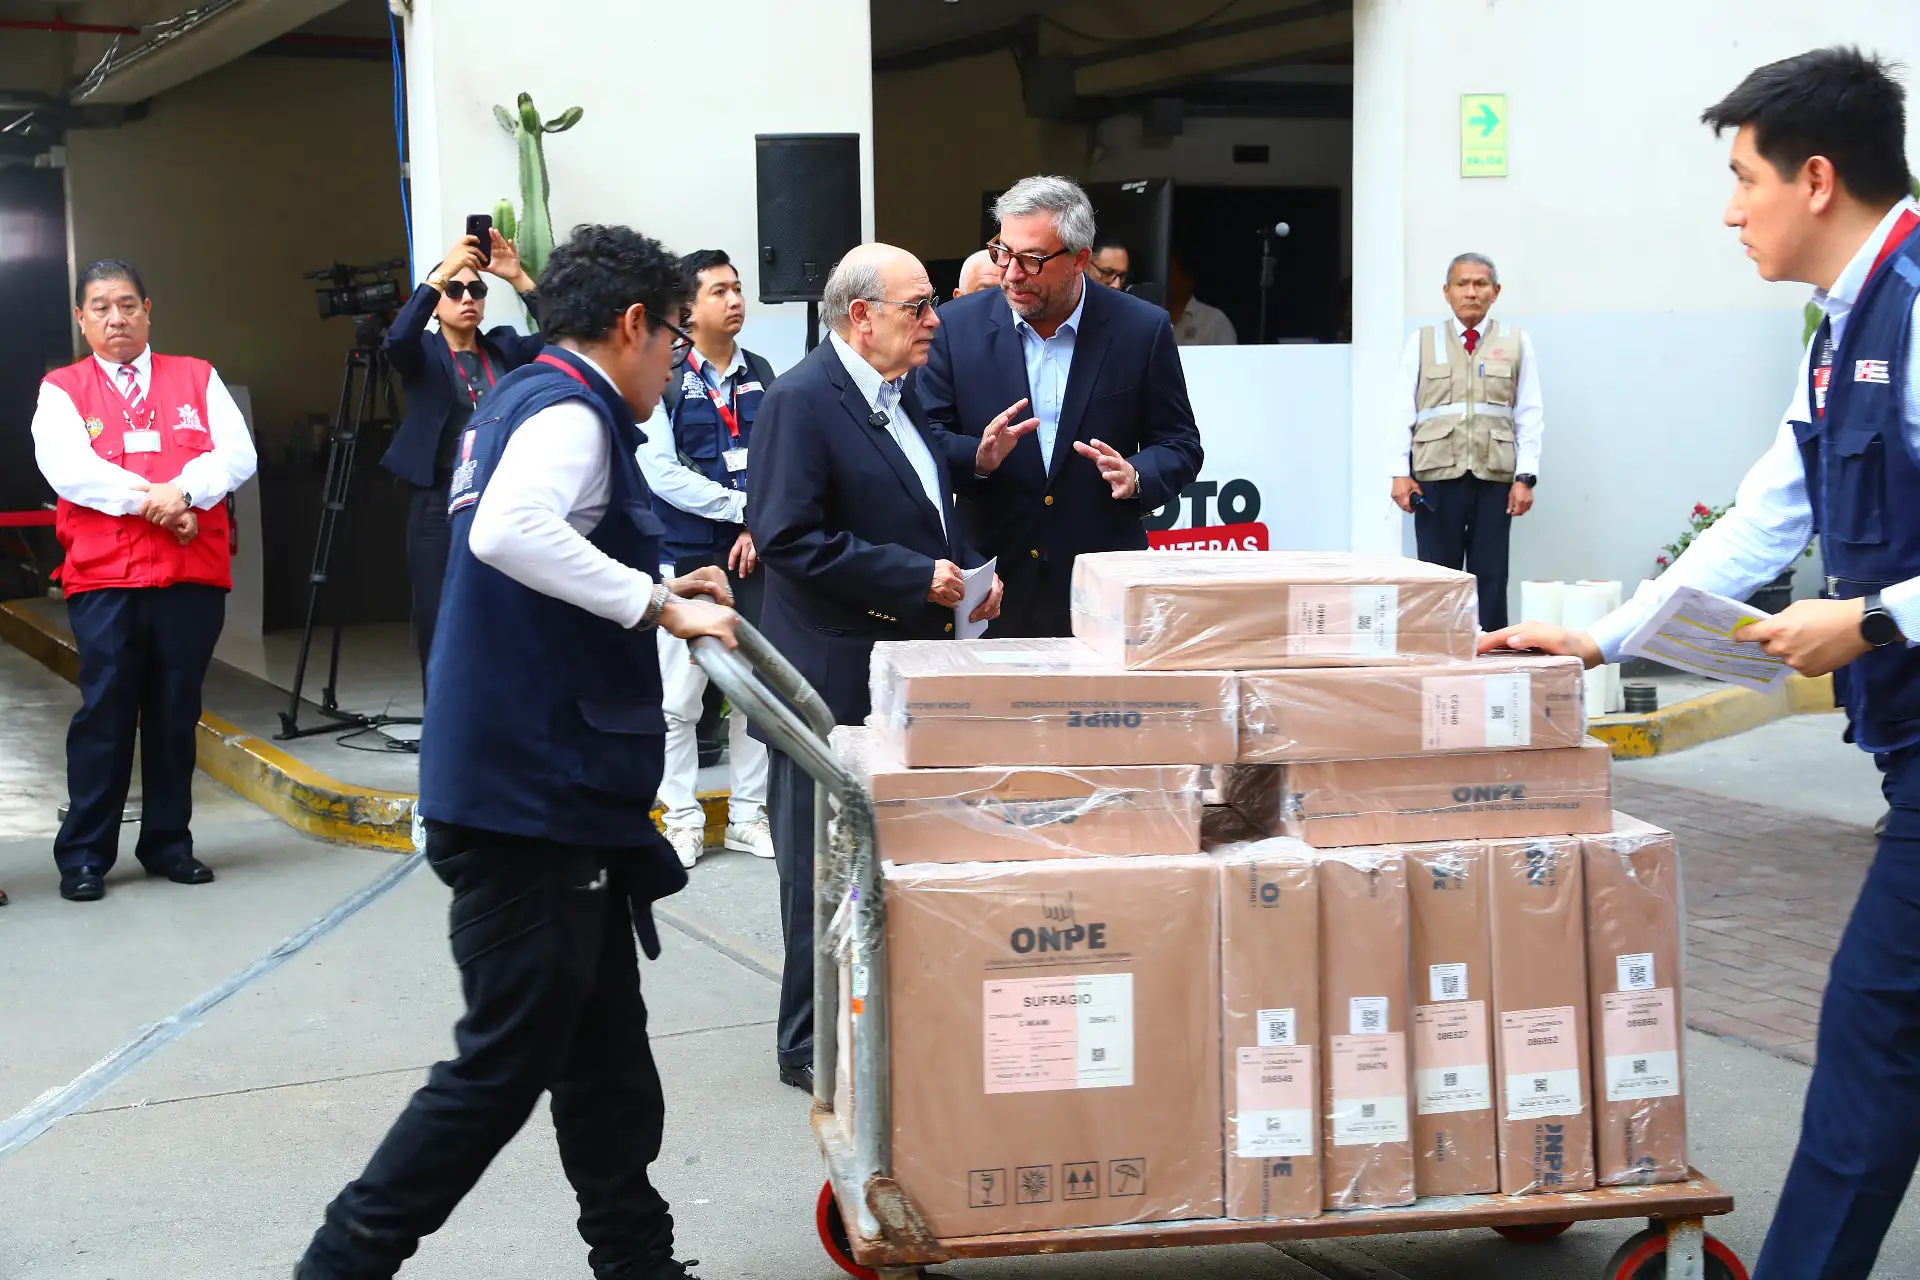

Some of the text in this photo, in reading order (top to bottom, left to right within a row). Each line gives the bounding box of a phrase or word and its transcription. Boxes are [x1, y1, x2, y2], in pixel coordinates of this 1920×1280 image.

[1466, 156, 1502, 165] SALIDA
[1067, 711, 1142, 729] ONPE
[1452, 784, 1527, 802] ONPE
[1010, 922, 1107, 954] ONPE
[1023, 993, 1092, 1008] SUFRAGIO
